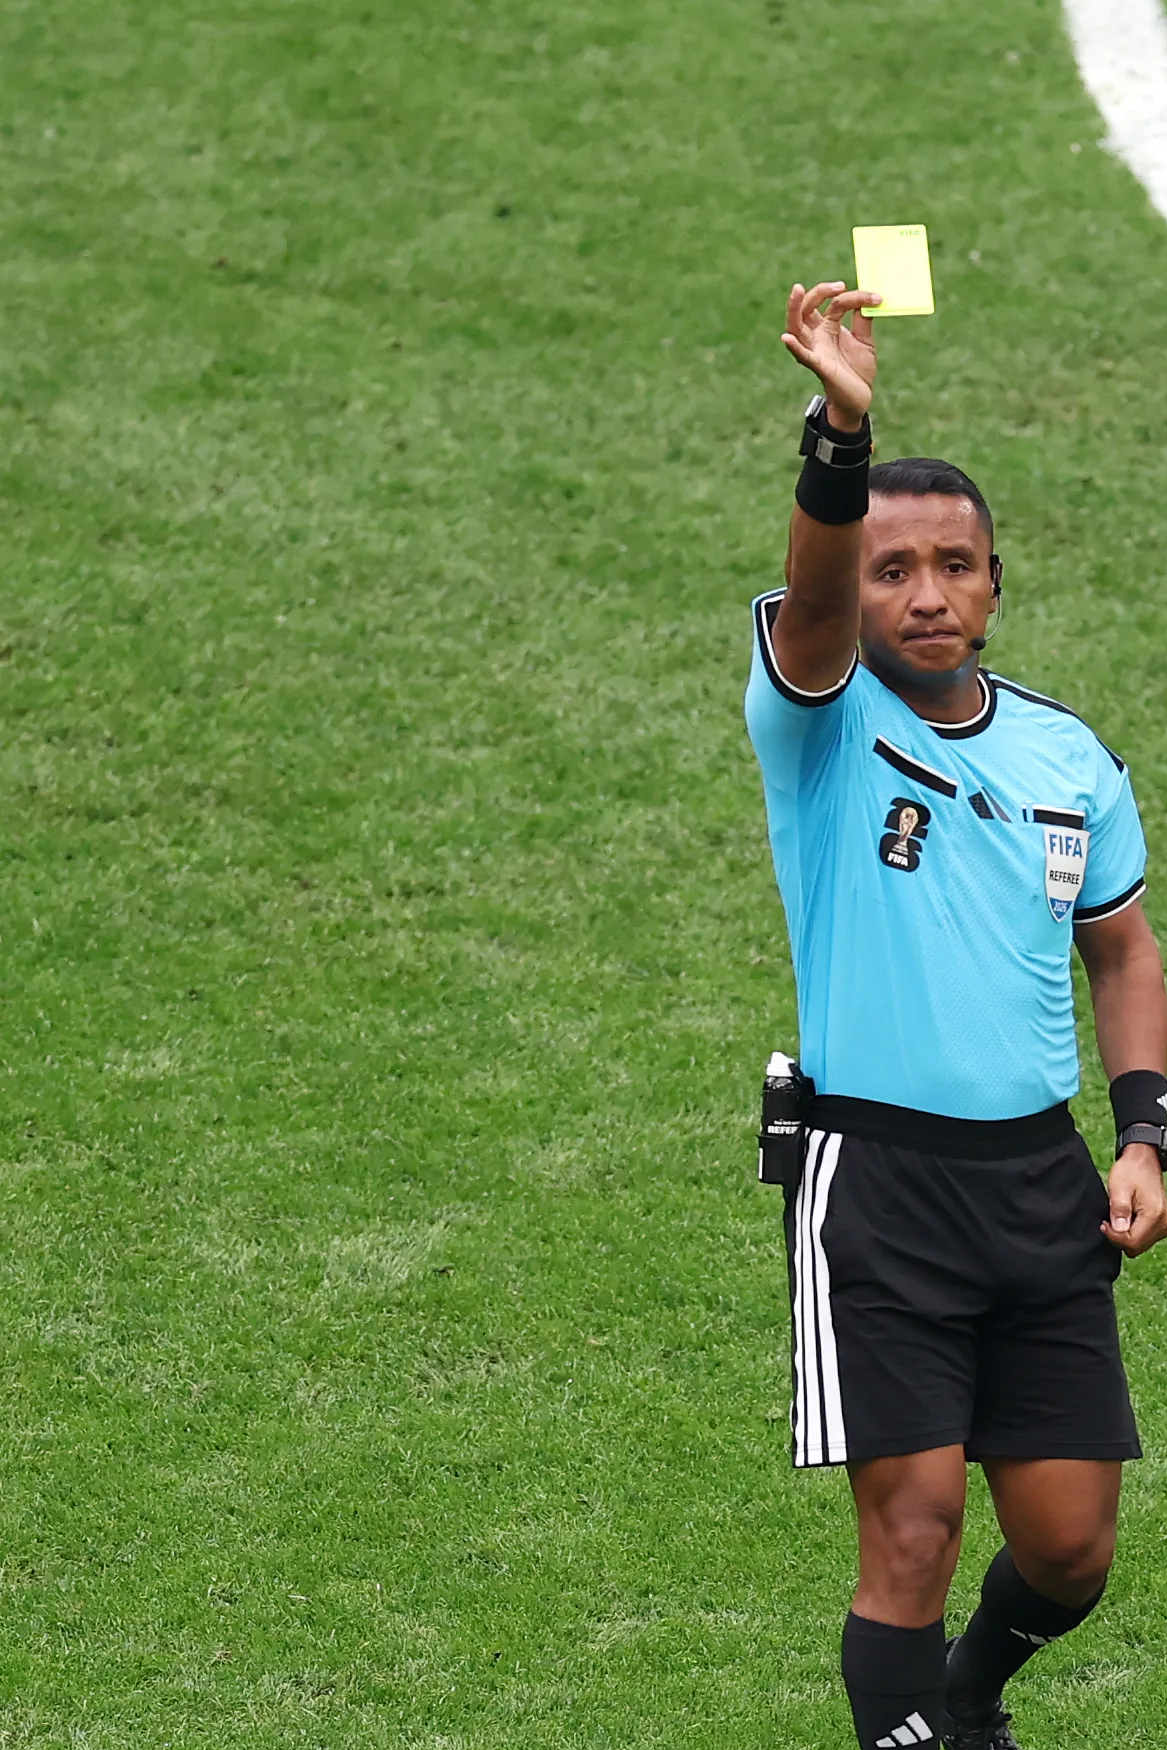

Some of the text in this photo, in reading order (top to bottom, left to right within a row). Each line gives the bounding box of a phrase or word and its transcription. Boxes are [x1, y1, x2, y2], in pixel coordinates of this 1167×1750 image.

[1049, 833, 1083, 859] FIFA
[887, 852, 909, 867] FIFA
[1049, 870, 1080, 885] REFEREE
